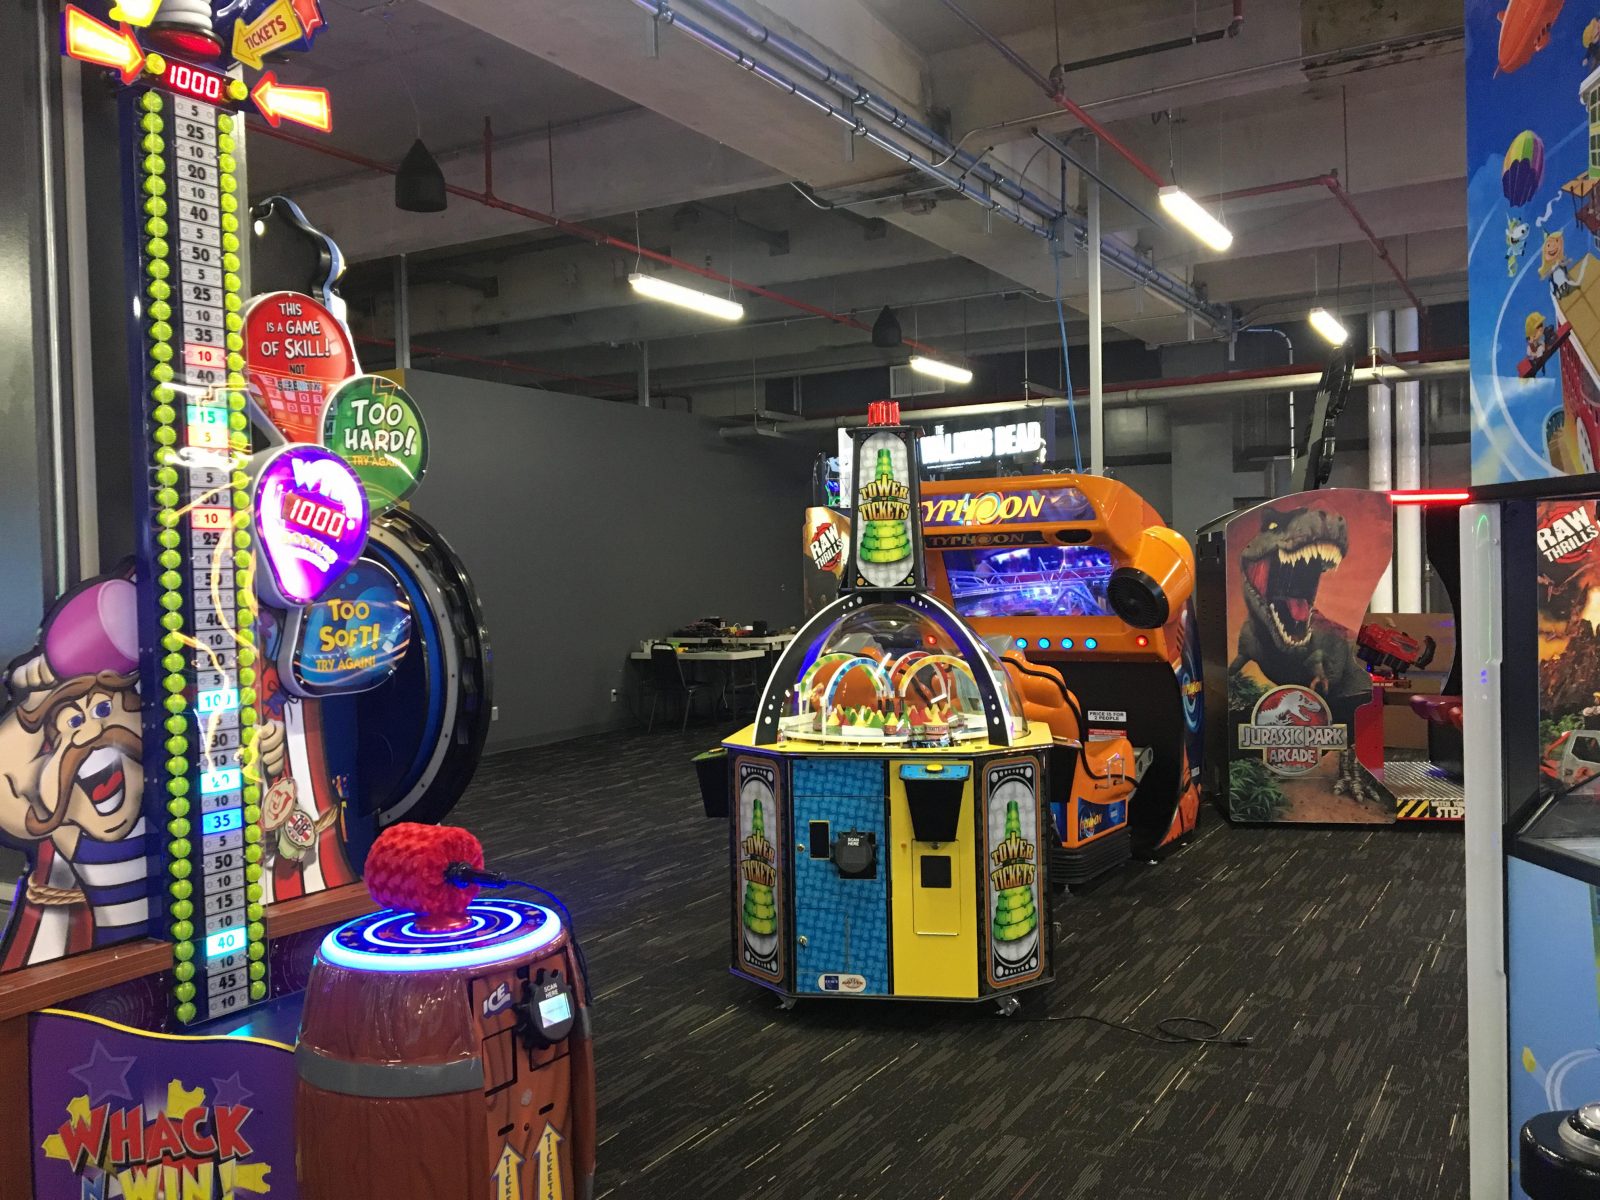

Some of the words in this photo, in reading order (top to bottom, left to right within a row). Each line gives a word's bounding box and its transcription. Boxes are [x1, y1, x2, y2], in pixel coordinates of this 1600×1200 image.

[243, 14, 287, 50] TICKETS
[169, 65, 221, 99] 1000
[191, 105, 198, 116] 5
[186, 124, 204, 140] 25
[190, 147, 203, 158] 10
[188, 165, 206, 180] 20
[191, 187, 205, 199] 10
[190, 207, 208, 221] 40
[196, 228, 203, 239] 5
[192, 246, 210, 261] 50
[198, 269, 205, 280] 5
[193, 286, 211, 301] 25
[196, 310, 210, 321] 10
[278, 303, 302, 317] THIS
[195, 328, 212, 342] 35
[266, 322, 275, 333] IS
[277, 323, 283, 333] A
[286, 321, 321, 335] GAME
[261, 341, 280, 356] OF
[285, 338, 331, 358] SKILL!
[197, 351, 212, 361] 10
[289, 364, 305, 374] NOT
[196, 371, 215, 384] 40
[200, 411, 216, 424] 15
[351, 399, 403, 426] TOO
[204, 432, 211, 442] 5
[344, 428, 416, 456] HARD!
[995, 421, 1041, 456] DEAD
[352, 454, 369, 466] TRY
[206, 472, 213, 483] 5
[859, 474, 909, 500] TOWER
[859, 501, 910, 520] TICKETS
[921, 492, 1046, 524] YPHOON
[204, 513, 218, 524] 10
[289, 499, 346, 537] 1000
[1537, 506, 1590, 551] RAW
[203, 532, 220, 545] 25
[810, 523, 839, 560] RAW
[931, 534, 1024, 546] TYPHOON
[1543, 525, 1599, 562] THRILLS
[815, 538, 843, 570] THRILLS
[328, 599, 370, 622] TOO
[209, 634, 222, 645] 10
[319, 624, 380, 652] SOFT!
[316, 658, 334, 672] TRY
[338, 656, 376, 671] AGAIN!
[213, 675, 220, 685] 5
[211, 733, 228, 748] 30
[1243, 727, 1304, 747] JURASSIC
[1305, 727, 1343, 746] PARK
[213, 755, 227, 767] 10
[1270, 749, 1316, 763] ARCADE
[214, 795, 229, 807] 10
[1437, 807, 1465, 818] STEP
[213, 814, 231, 829] 35
[220, 836, 226, 846] 5
[741, 830, 775, 864] TOWER
[991, 831, 1034, 866] TOWER
[215, 854, 232, 869] 50
[740, 859, 776, 887] TICKETS
[991, 864, 1035, 891] TICKETS
[217, 875, 231, 887] 10
[216, 894, 233, 909] 15
[219, 916, 232, 928] 10
[218, 935, 235, 948] 40
[221, 956, 234, 968] 10
[219, 974, 236, 989] 45
[544, 983, 557, 993] SCAN
[483, 983, 511, 1014] ICE
[546, 989, 559, 998] HERE
[221, 996, 235, 1009] 10
[58, 1103, 253, 1173] WHACK
[118, 1158, 236, 1200] WIN!
